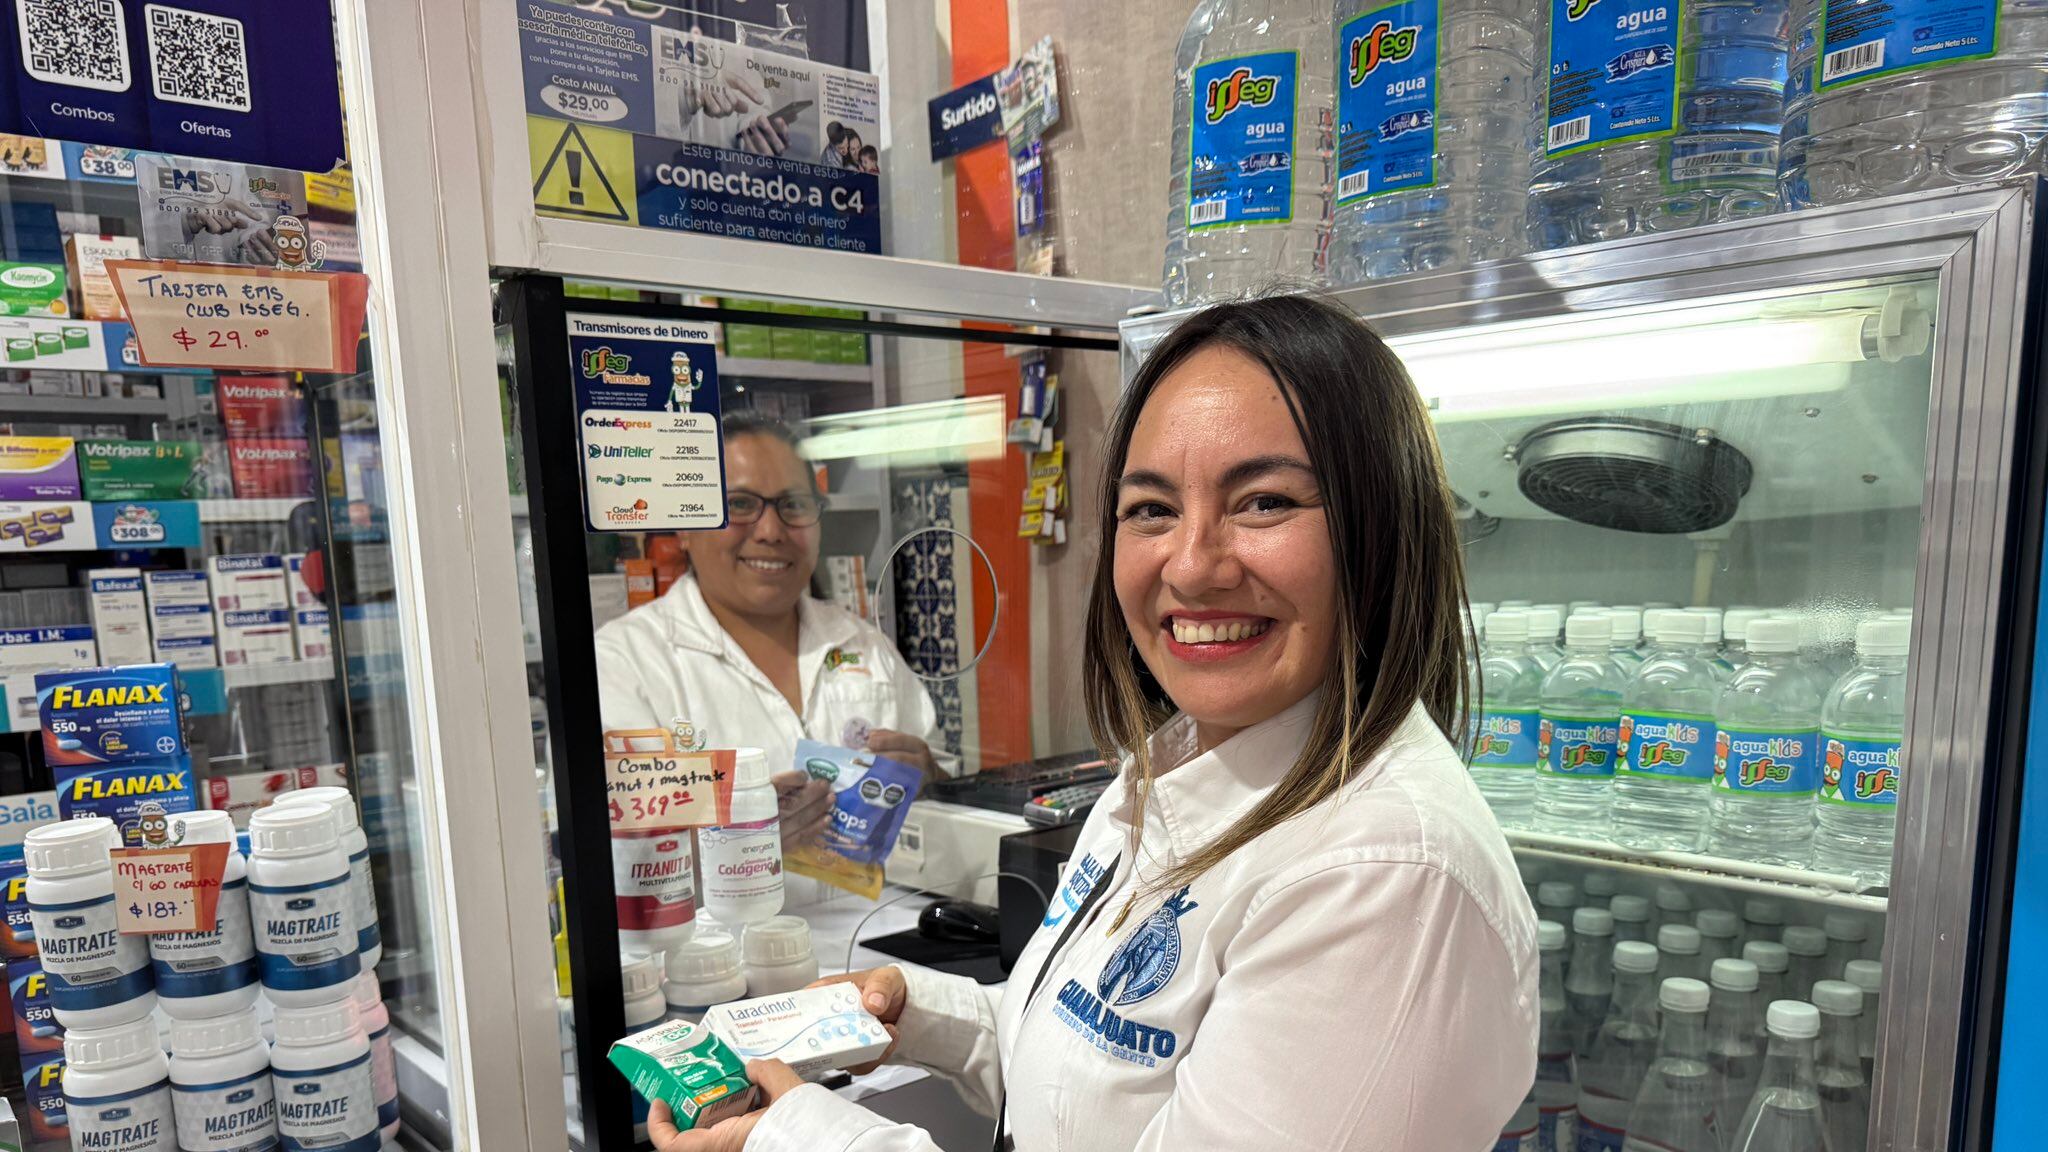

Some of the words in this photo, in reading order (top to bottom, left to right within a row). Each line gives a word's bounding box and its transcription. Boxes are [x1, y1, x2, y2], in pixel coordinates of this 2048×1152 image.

[529, 4, 543, 18] Ya
[545, 11, 582, 27] puedes
[582, 17, 616, 34] contar
[616, 26, 635, 38] con
[1616, 6, 1667, 31] agua
[518, 17, 560, 37] asesoría
[560, 26, 597, 44] médica
[598, 33, 648, 57] telefónica,
[534, 35, 559, 47] gracias
[565, 40, 576, 50] los
[576, 43, 602, 55] servicios
[605, 49, 618, 59] que
[618, 52, 633, 61] EMS
[550, 48, 568, 58] pone
[660, 35, 709, 67] EMS
[529, 54, 543, 63] con
[543, 55, 550, 64] la
[550, 58, 577, 72] compra
[577, 62, 586, 71] de
[586, 64, 594, 73] la
[594, 65, 620, 81] Tarjeta
[746, 58, 760, 70] De
[762, 63, 788, 77] venta
[789, 69, 811, 82] aquí
[551, 74, 580, 88] Costo
[582, 80, 617, 96] ANUAL
[1385, 76, 1427, 98] agua
[558, 91, 609, 112] $29.00
[940, 92, 997, 131] Surtido
[50, 102, 116, 124] Combos
[180, 120, 232, 139] Ofertas
[1246, 121, 1286, 138] agua
[682, 143, 712, 160] Este
[714, 149, 754, 169] punto
[756, 154, 774, 170] de
[776, 159, 811, 175] venta
[157, 166, 216, 193] EMS
[655, 163, 802, 205] conectado
[808, 187, 823, 208] a
[831, 187, 864, 214] C4
[678, 197, 687, 211] y
[690, 196, 719, 214] solo
[721, 201, 766, 219] cuenta
[768, 207, 792, 224] con
[794, 207, 807, 225] el
[808, 210, 848, 230] dinero
[657, 212, 723, 235] suficiente
[725, 223, 755, 241] para
[757, 222, 812, 246] atención
[814, 229, 825, 246] al
[827, 232, 867, 252] cliente
[138, 274, 229, 299] TARJETA
[241, 285, 284, 301] EMS
[186, 302, 230, 318] CLUB
[172, 326, 197, 352] $
[573, 320, 651, 336] Transmisores
[653, 325, 668, 337] de
[671, 326, 709, 340] Dinero
[603, 372, 651, 386] Farmacias
[223, 384, 287, 399] Votripax
[584, 416, 652, 431] OrderExpress
[673, 418, 697, 428] 22417
[83, 442, 151, 458] Votripax
[236, 446, 297, 462] Votripax
[603, 445, 654, 459] UniTeller
[676, 446, 700, 455] 22185
[596, 475, 613, 484] Pago
[626, 475, 652, 484] Express
[676, 473, 704, 482] 20609
[605, 511, 649, 521] Transfer
[680, 503, 705, 513] 21964
[612, 506, 634, 514] Cloud
[218, 557, 264, 570] Binotal
[226, 611, 270, 624] Binotal
[52, 682, 168, 710] FLANAX
[52, 721, 77, 734] 550
[618, 757, 677, 774] Combo
[73, 770, 188, 801] FLANAX
[0, 798, 58, 826] Gaia
[832, 805, 868, 830] rops
[117, 861, 194, 879] MAGTRATE
[718, 861, 773, 877] Colágeno
[149, 880, 167, 891] 60
[267, 911, 341, 936] MAGTRATE
[41, 929, 118, 955] MAGTRATE
[176, 962, 187, 970] 60
[70, 975, 82, 983] 60
[26, 1008, 52, 1022] 550
[727, 998, 798, 1022] Laracintol
[1056, 977, 1177, 1059] GUANAJUATO
[1110, 1046, 1157, 1068] GENTE
[39, 1097, 65, 1112] 550
[280, 1095, 349, 1119] MAGTRATE
[204, 1098, 275, 1134] MAGTRATE
[81, 1118, 160, 1148] MAGTRATE
[208, 1132, 234, 1142] MEZCLA
[235, 1130, 244, 1138] DE
